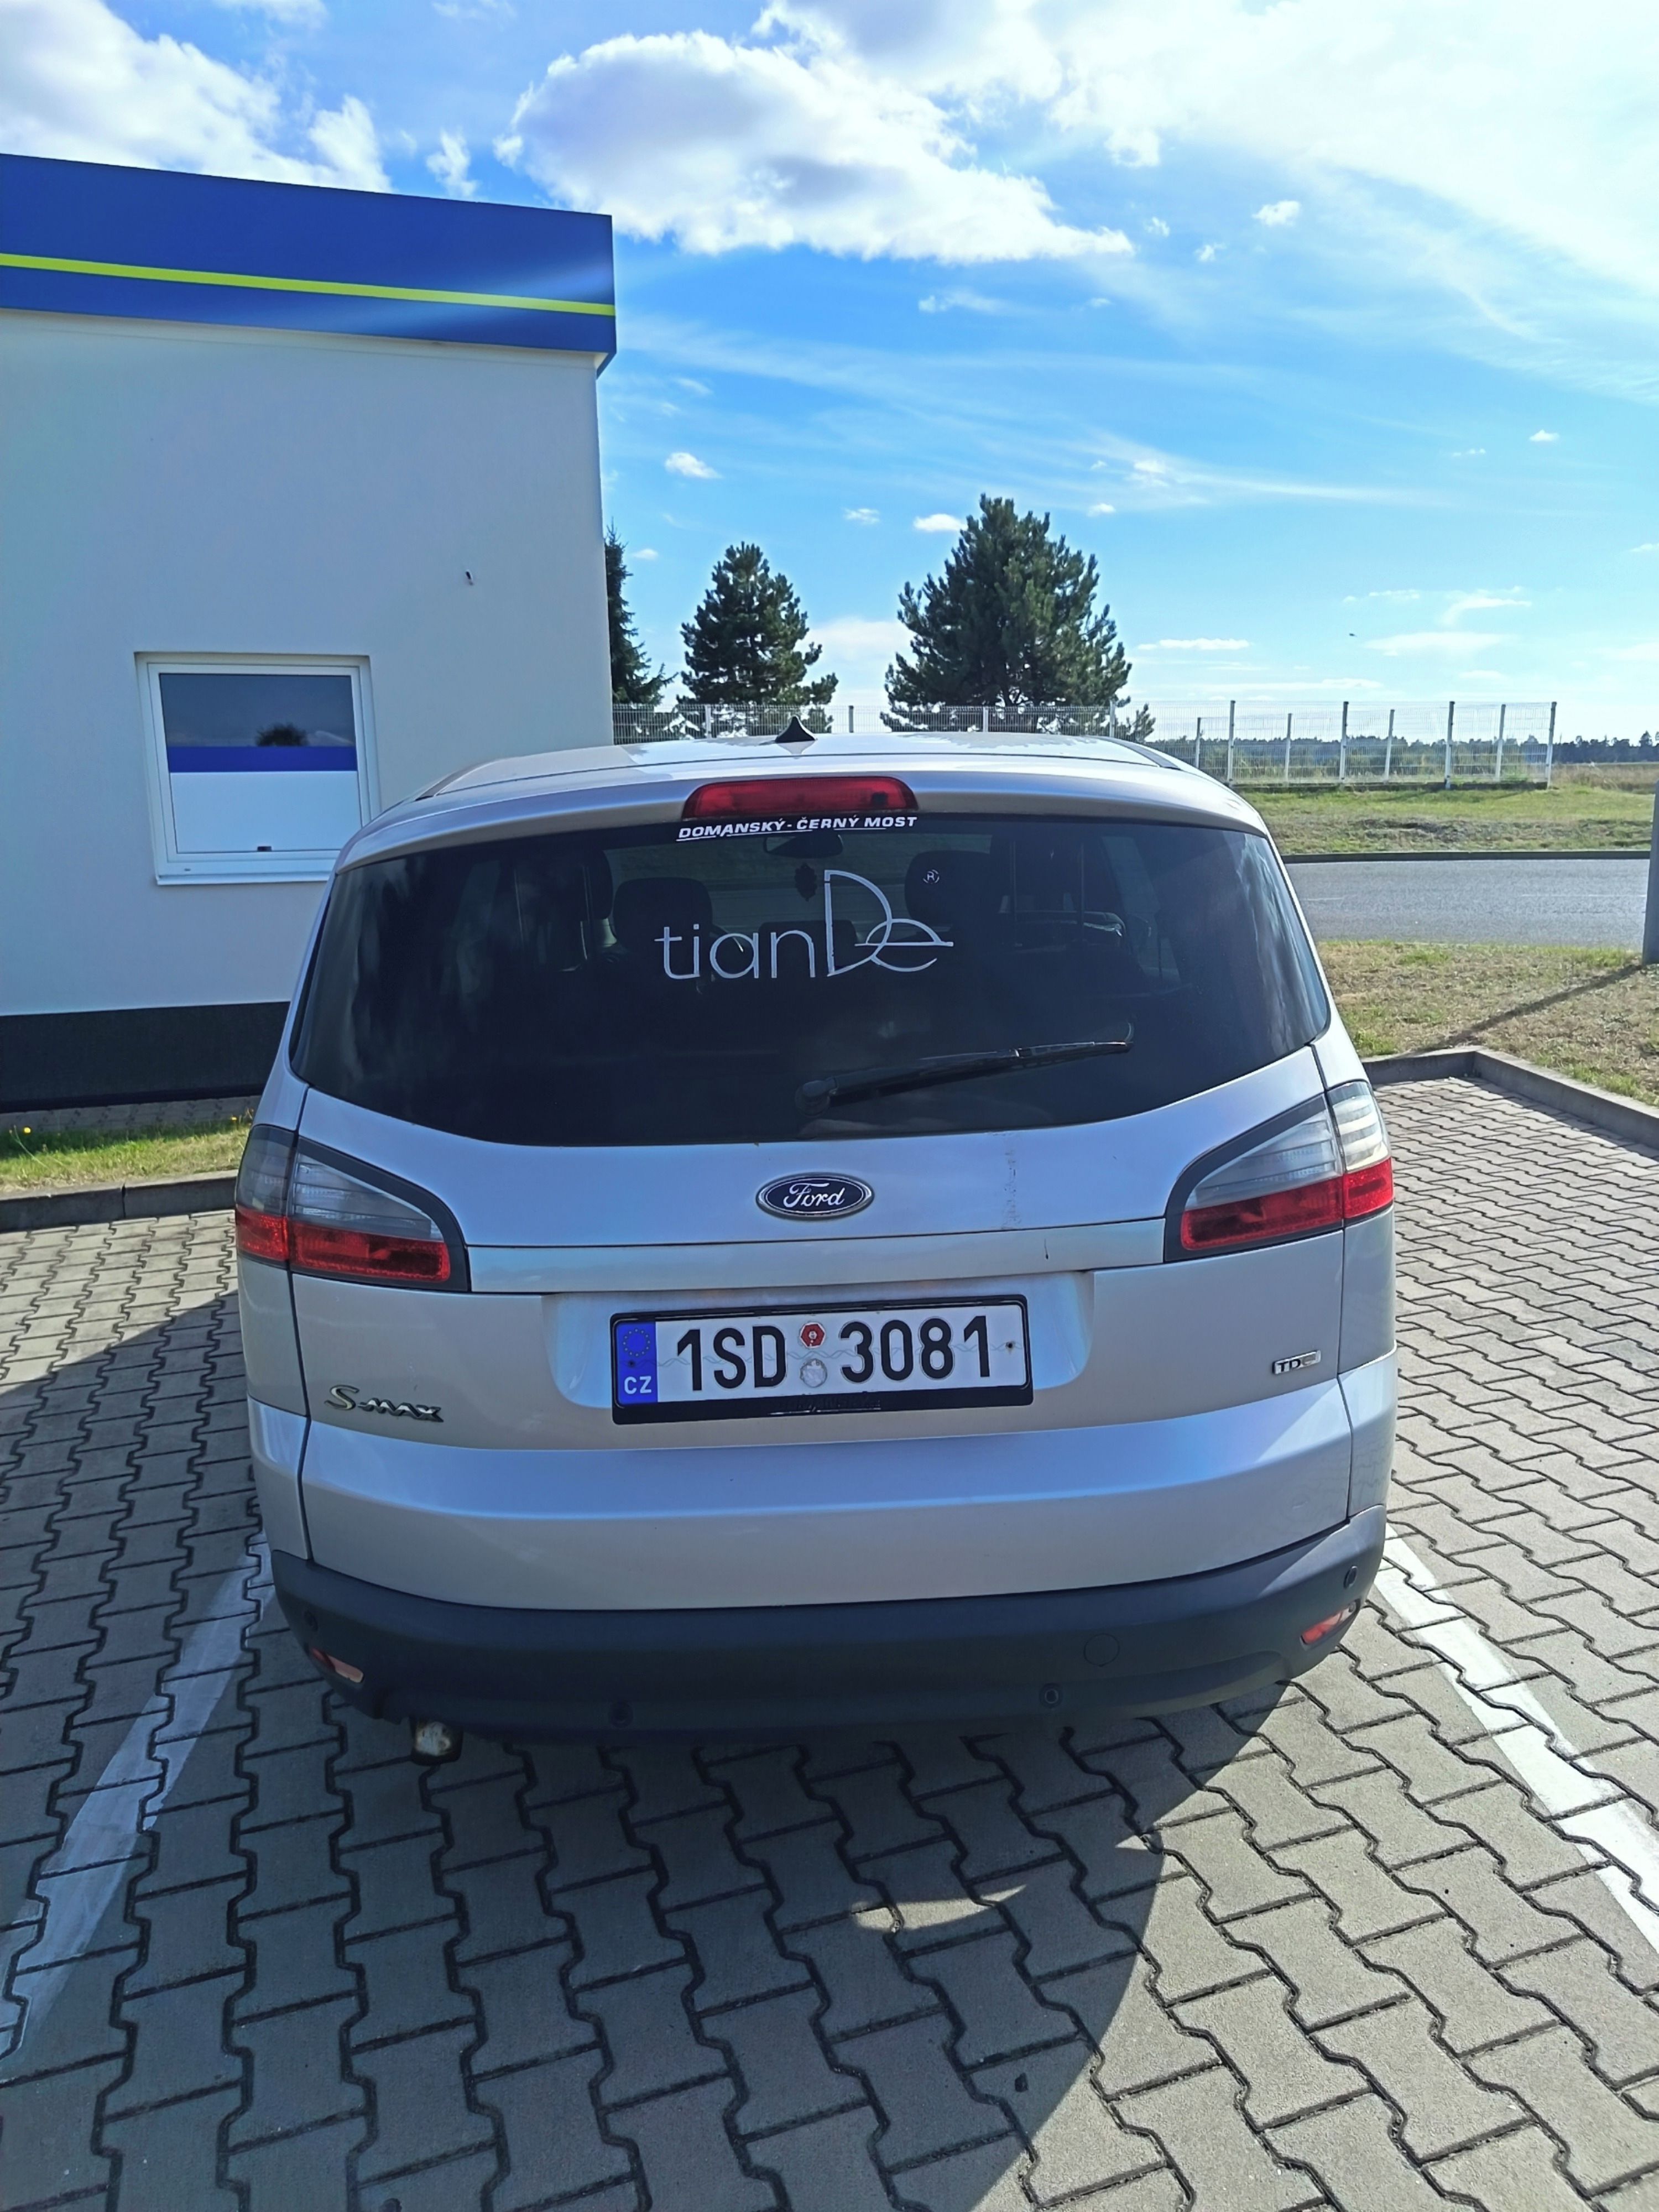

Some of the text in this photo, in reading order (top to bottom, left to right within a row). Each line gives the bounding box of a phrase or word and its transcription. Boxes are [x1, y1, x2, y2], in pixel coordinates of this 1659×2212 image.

[796, 815, 859, 830] ČERNÝ
[864, 816, 917, 827] MOST
[783, 1182, 845, 1208] Ford
[676, 1315, 990, 1391] 1SD 3081
[624, 1375, 653, 1395] CZ
